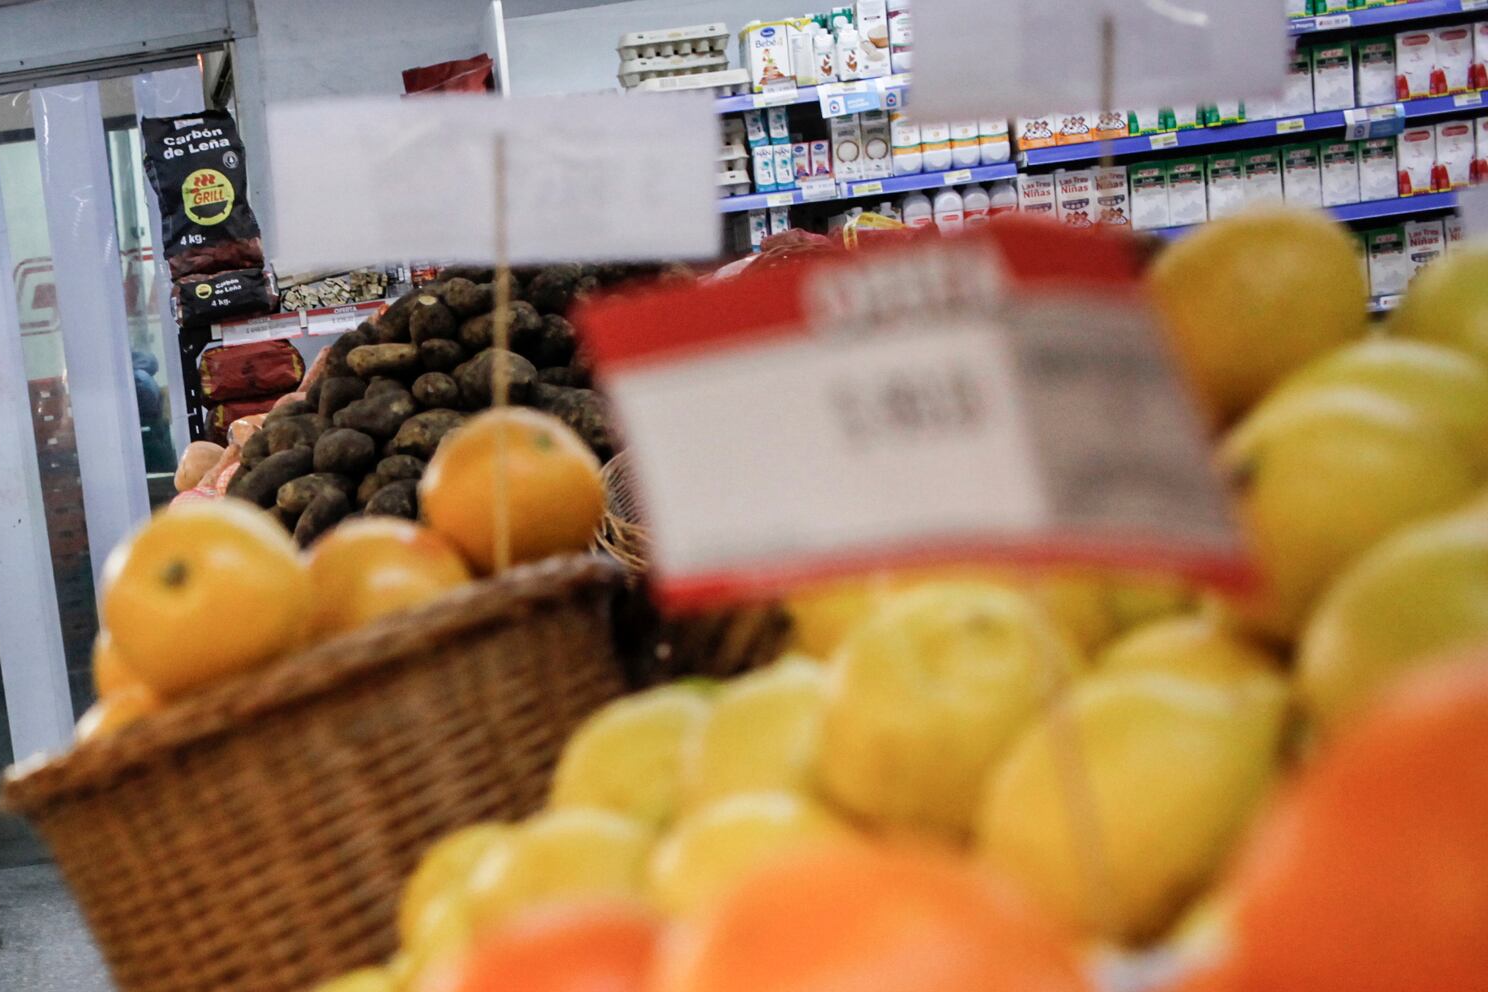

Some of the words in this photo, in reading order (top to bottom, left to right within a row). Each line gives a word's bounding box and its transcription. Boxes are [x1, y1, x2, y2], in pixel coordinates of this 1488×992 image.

[163, 127, 223, 146] Carbón
[163, 147, 184, 159] de
[188, 138, 230, 154] Leña
[1023, 188, 1051, 199] Niñas
[1060, 184, 1089, 194] Niñas
[194, 189, 225, 205] GRILL
[180, 236, 187, 246] 4
